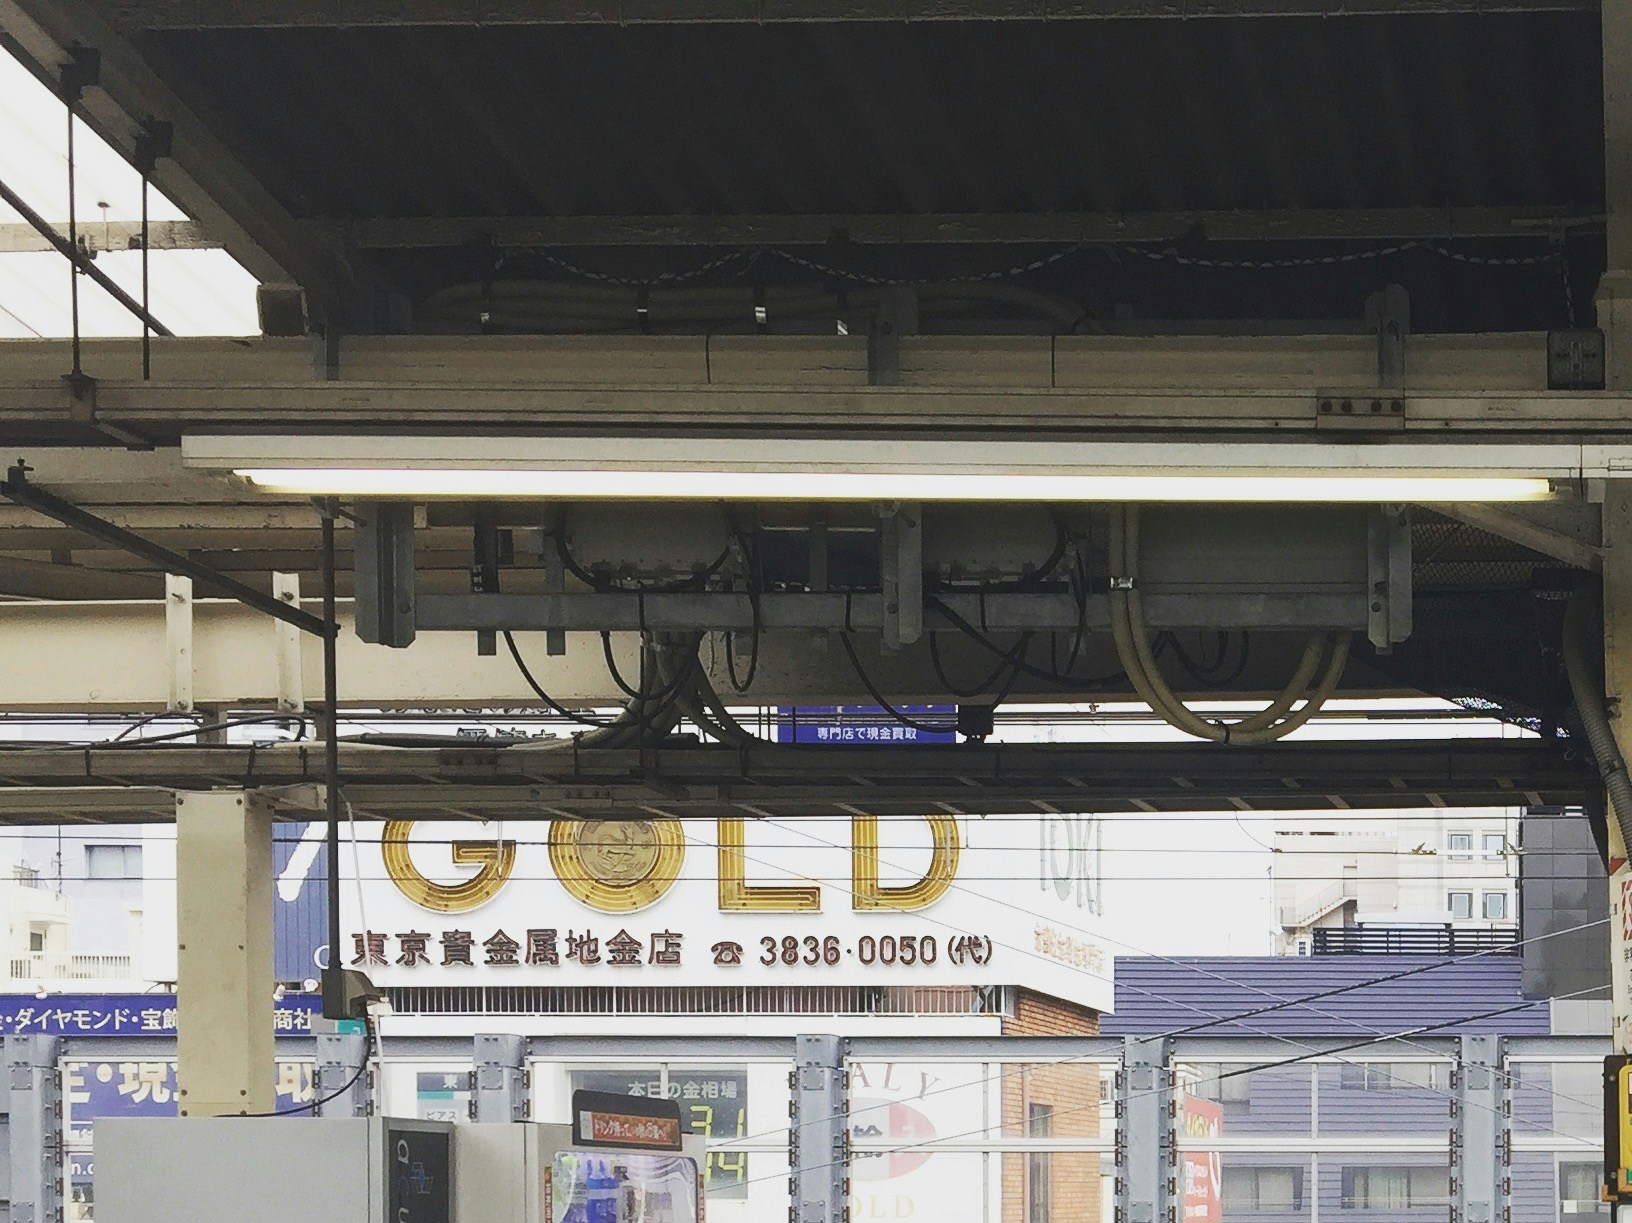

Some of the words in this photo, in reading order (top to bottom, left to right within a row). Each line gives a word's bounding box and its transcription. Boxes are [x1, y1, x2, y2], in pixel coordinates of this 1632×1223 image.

[350, 929, 684, 968] 東京貴金属地金店
[0, 1009, 178, 1031] ・ダイヤモンド・宝飾
